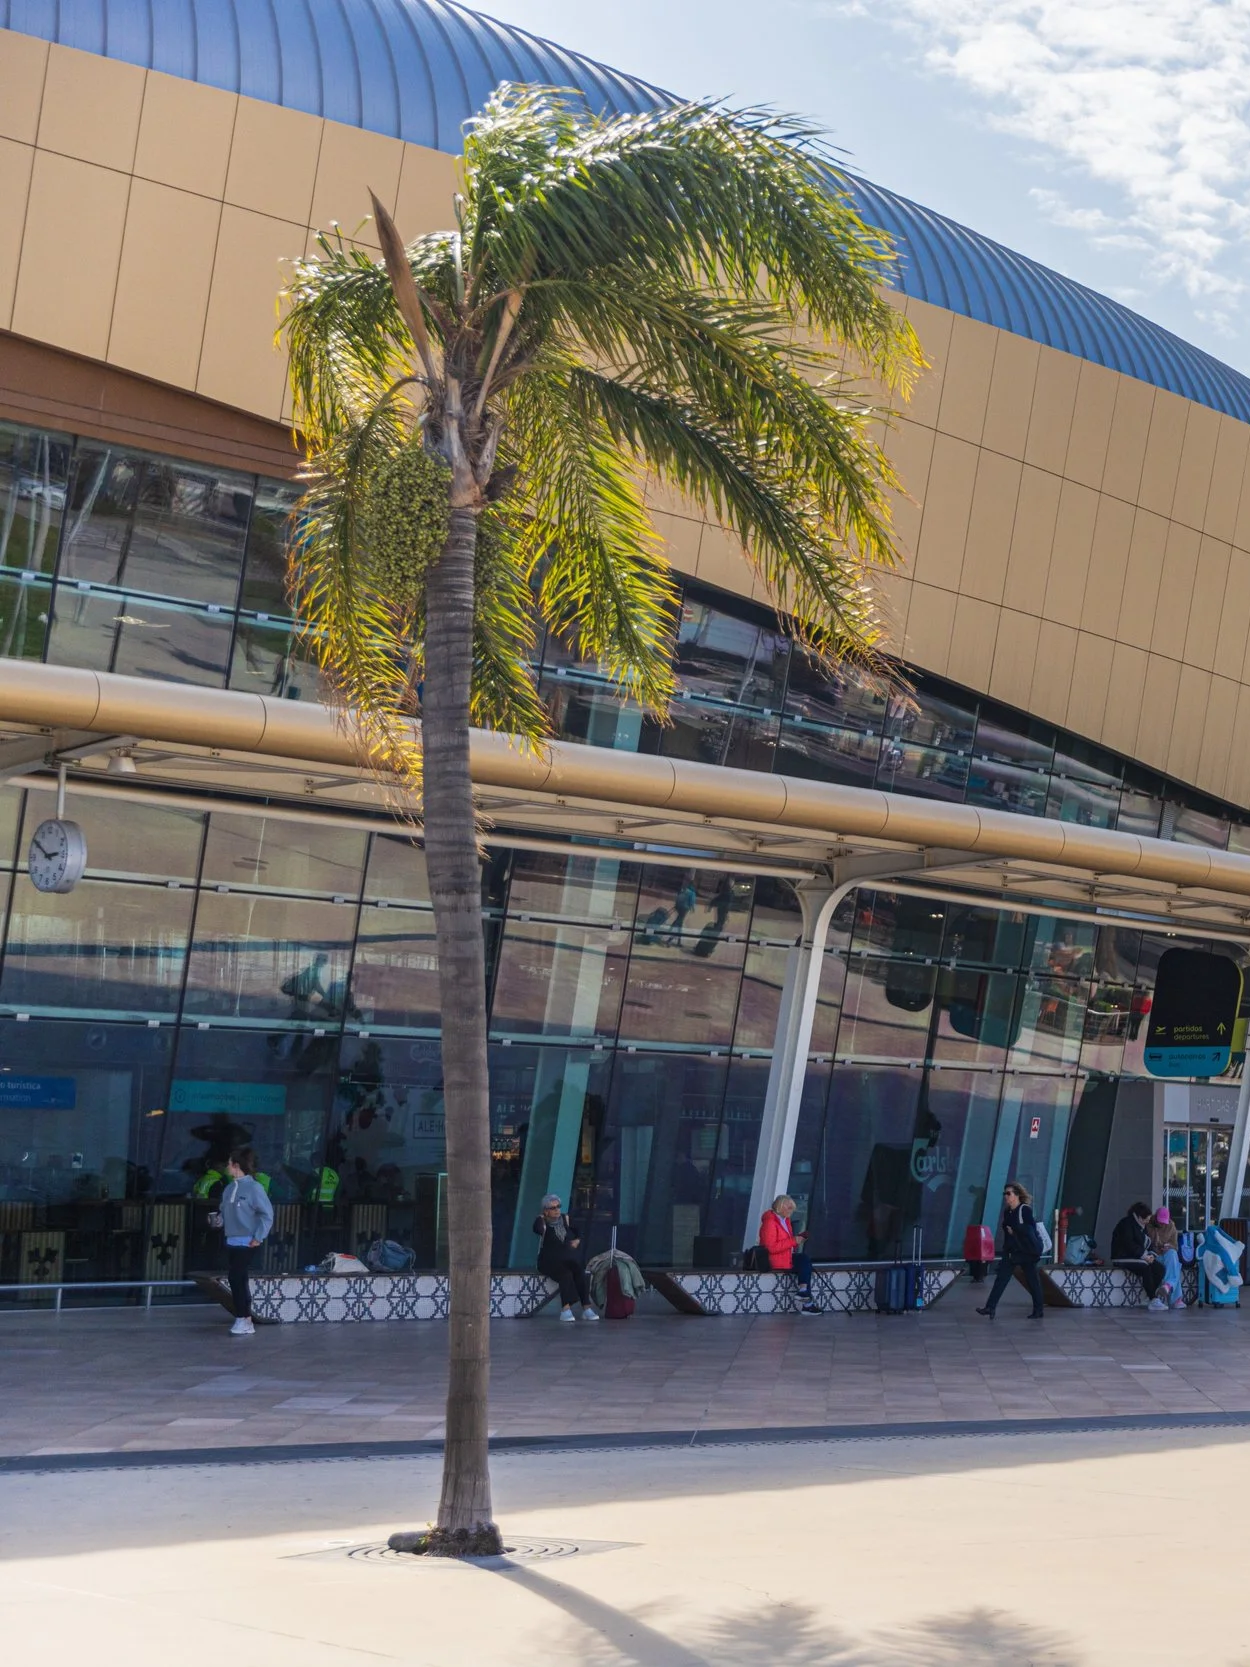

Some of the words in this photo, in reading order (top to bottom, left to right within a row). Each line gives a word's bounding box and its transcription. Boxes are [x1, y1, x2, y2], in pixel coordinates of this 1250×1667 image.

[1173, 1024, 1203, 1033] partidas
[1173, 1033, 1209, 1041] departures
[417, 1119, 445, 1132] ALE-H
